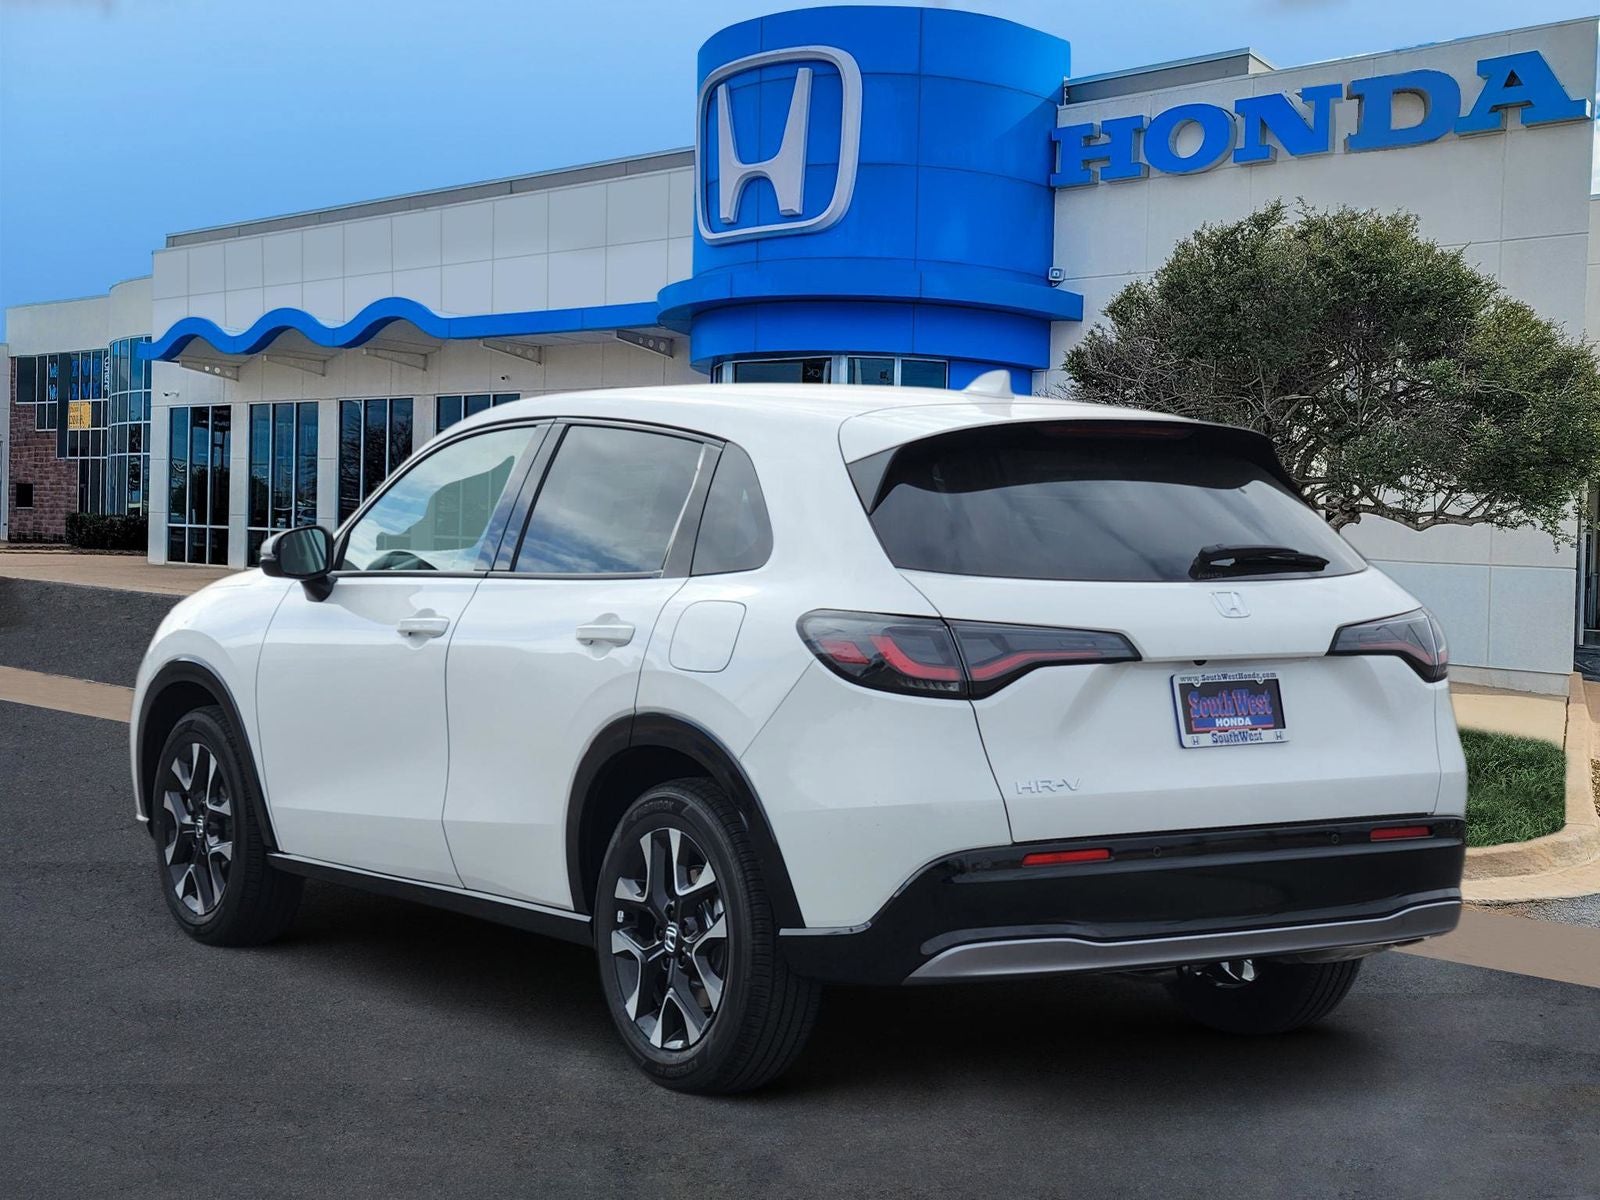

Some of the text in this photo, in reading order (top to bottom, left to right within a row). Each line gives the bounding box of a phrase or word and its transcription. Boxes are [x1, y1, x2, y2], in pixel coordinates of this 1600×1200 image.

[1050, 50, 1591, 188] HONDA
[1215, 717, 1252, 727] HONDA
[1015, 778, 1080, 795] HR-V
